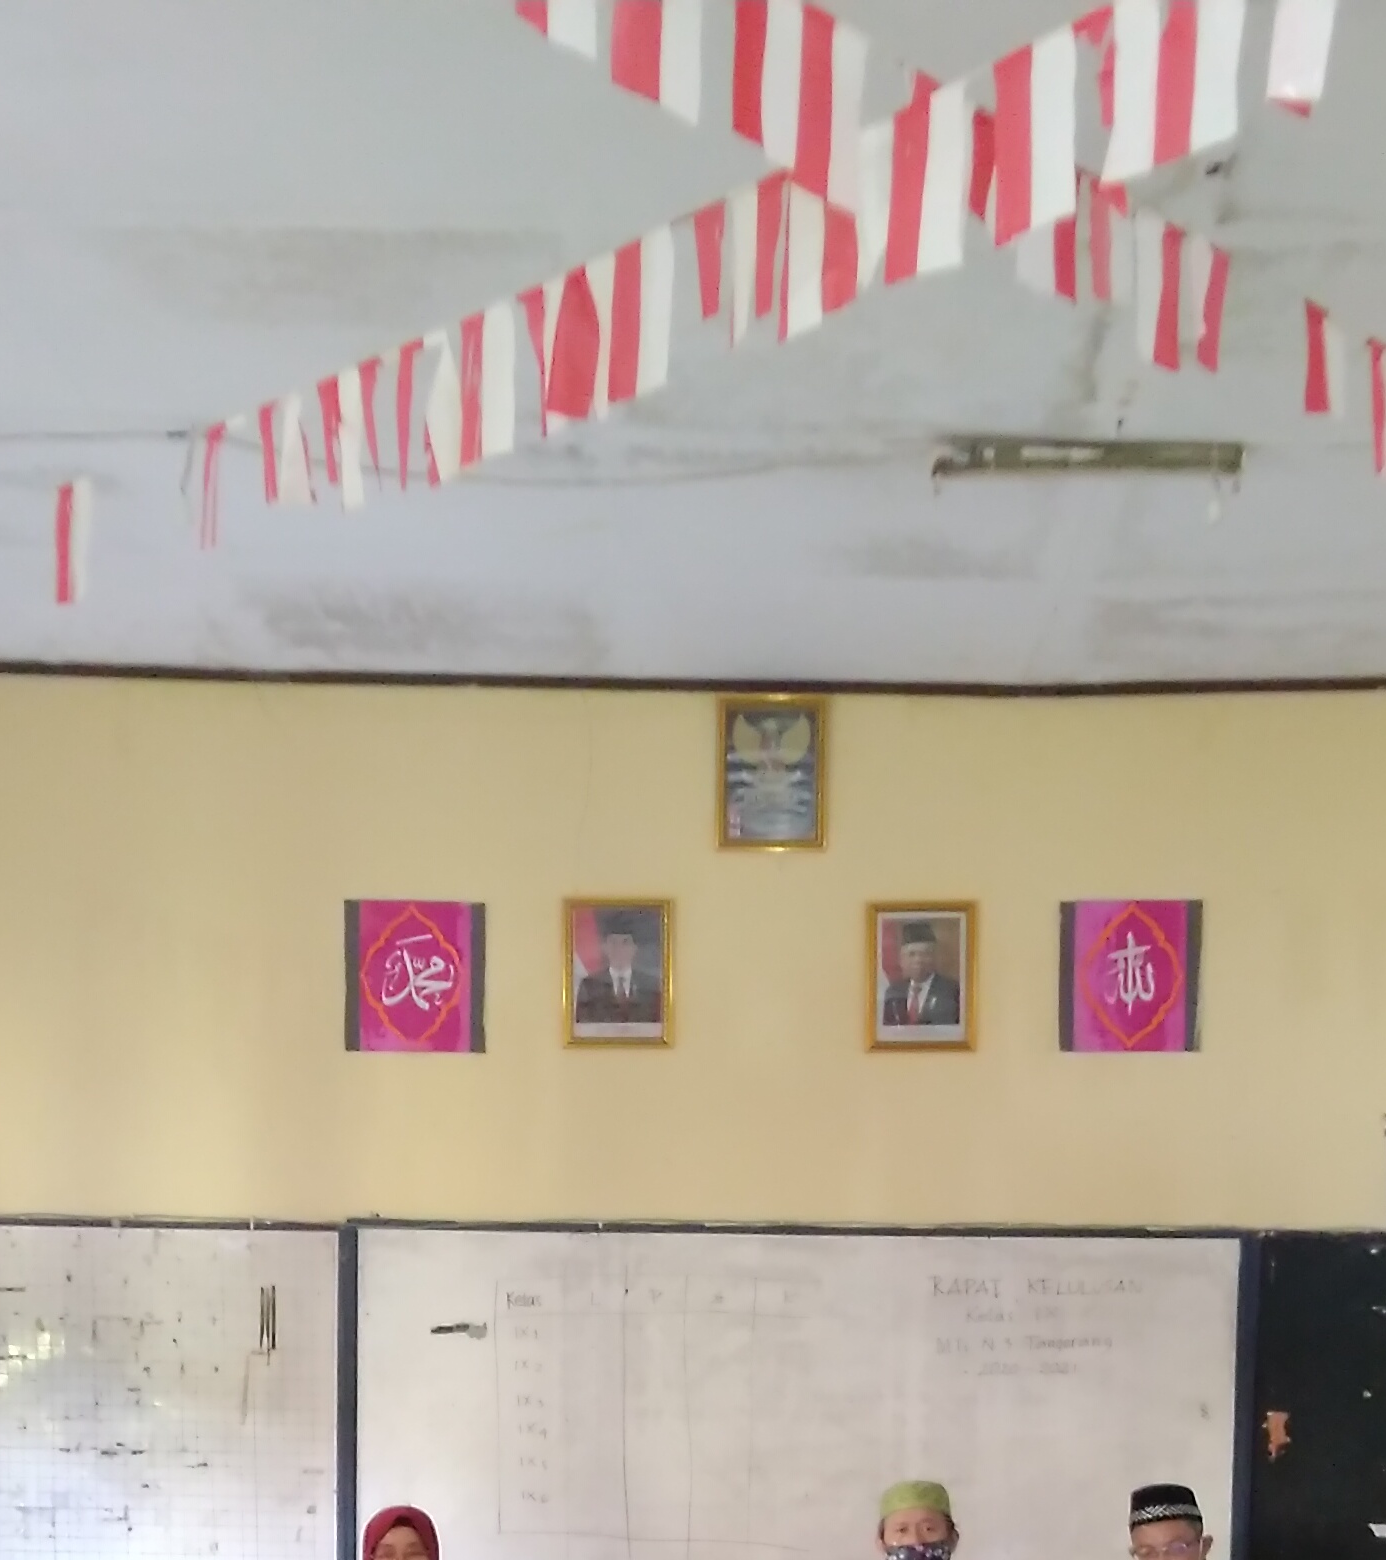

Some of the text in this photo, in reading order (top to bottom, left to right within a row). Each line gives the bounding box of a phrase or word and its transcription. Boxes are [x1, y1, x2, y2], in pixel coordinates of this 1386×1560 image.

[928, 1274, 1143, 1298] RAPAT KELULUSAN
[506, 1291, 542, 1309] Kelas
